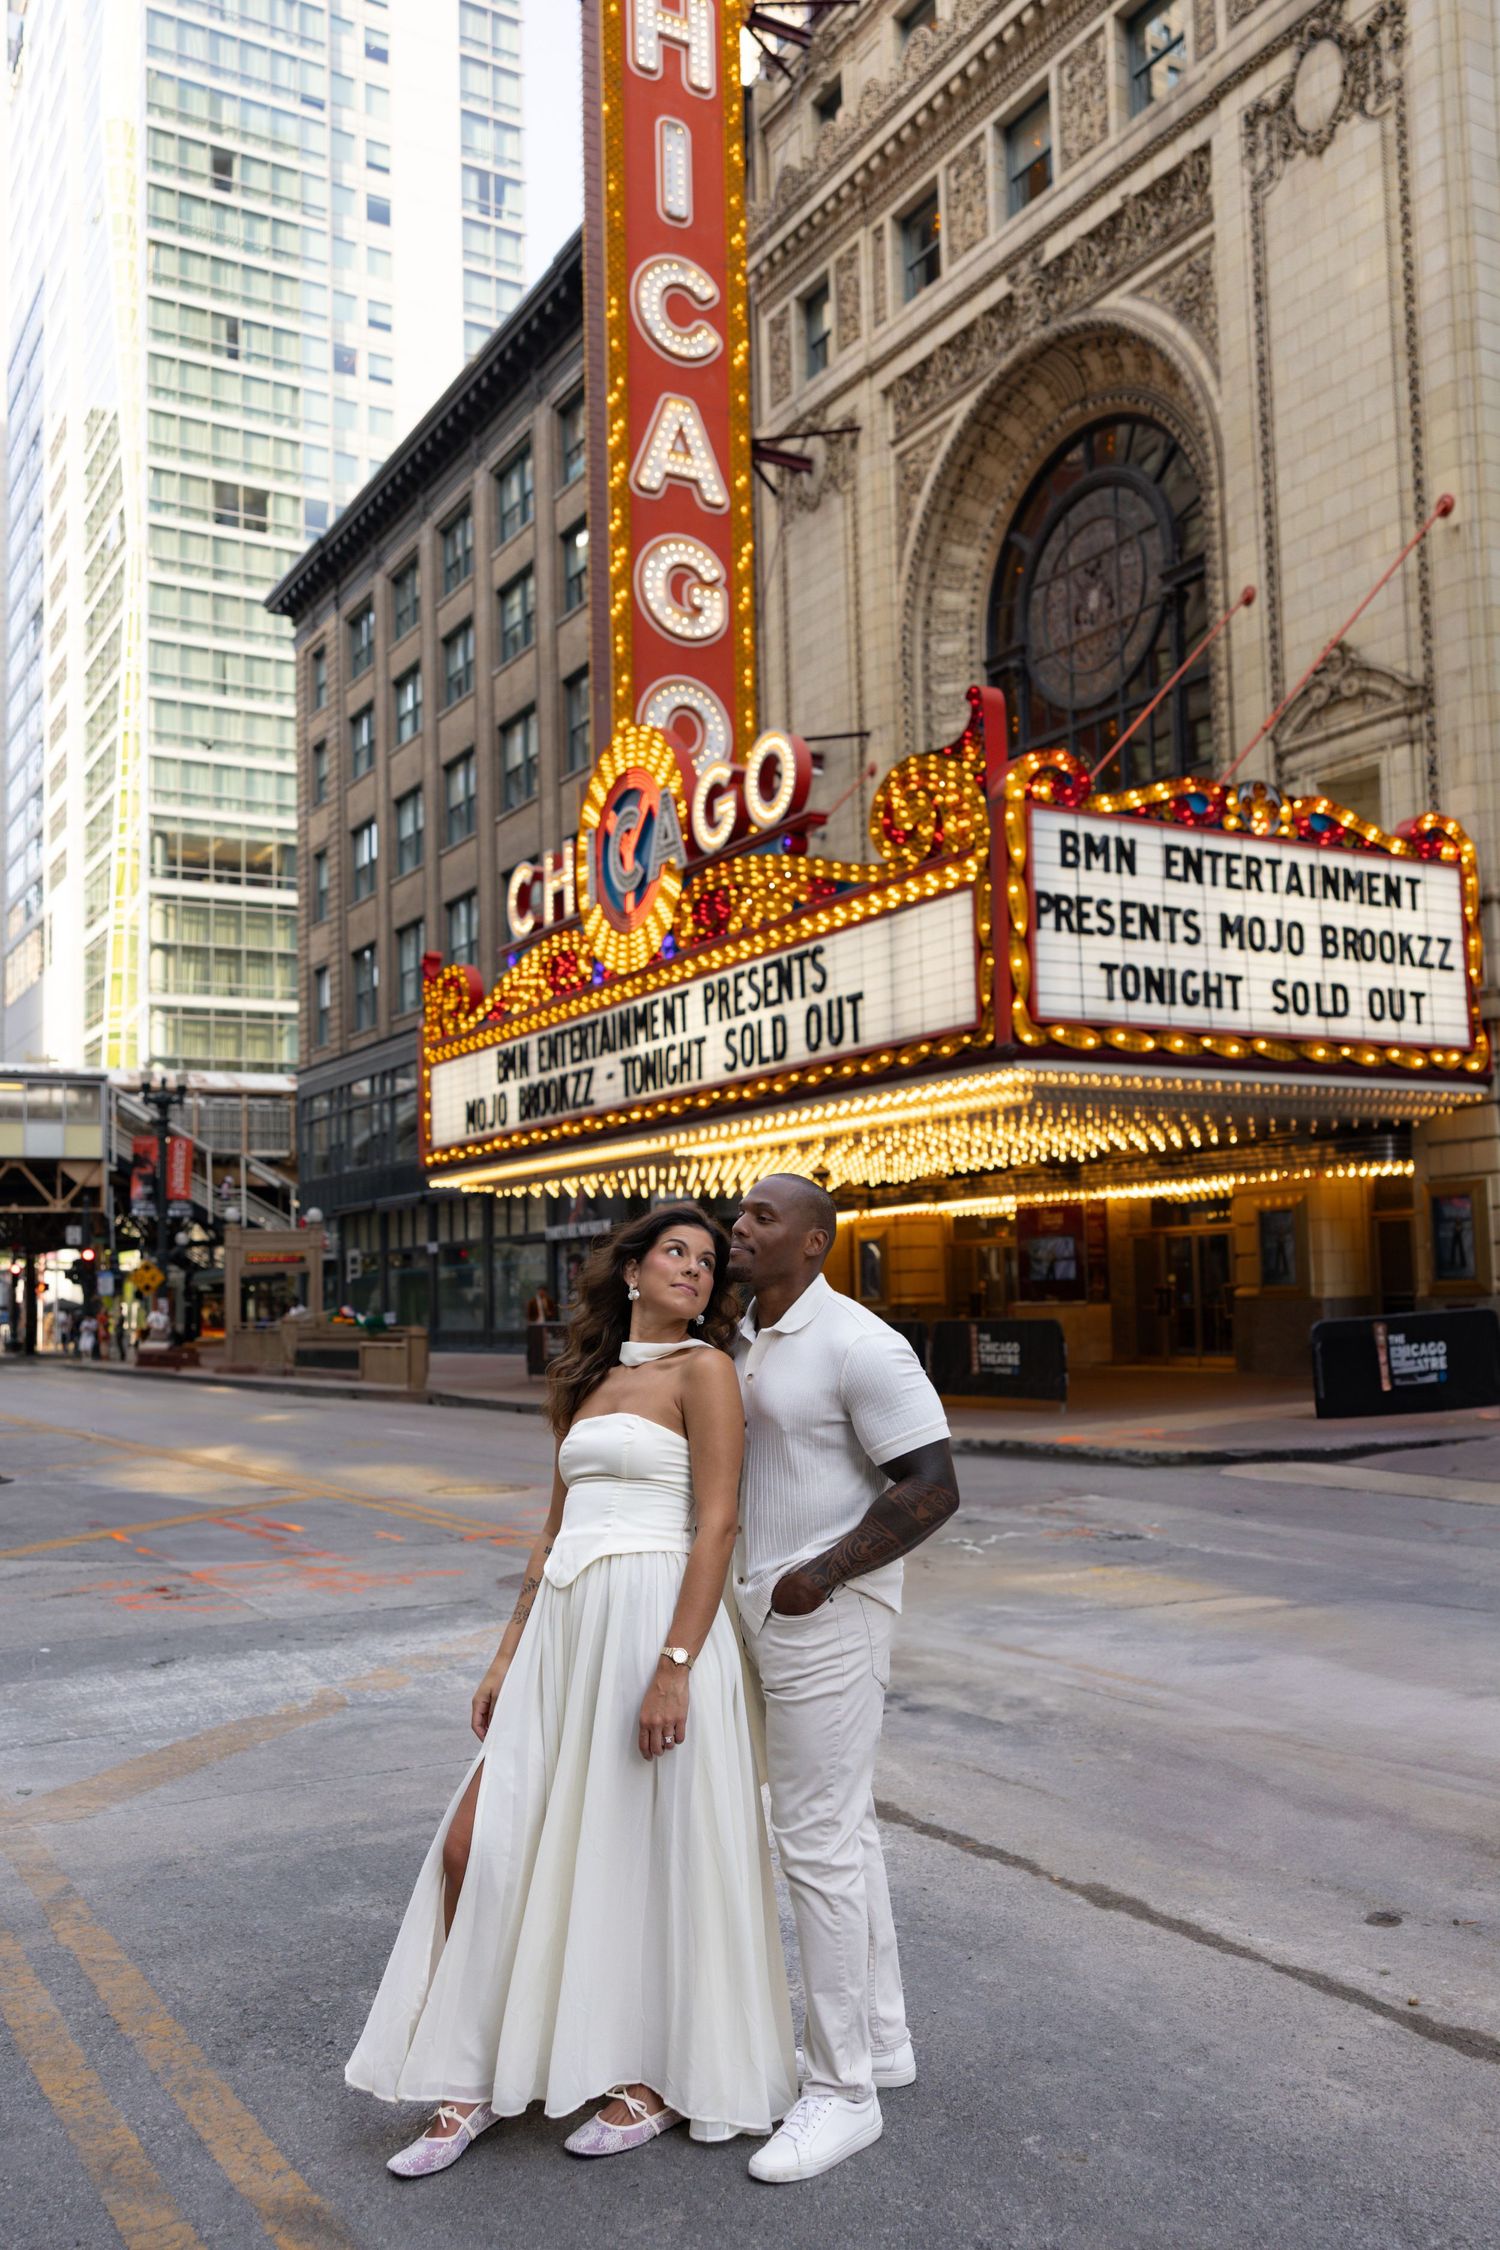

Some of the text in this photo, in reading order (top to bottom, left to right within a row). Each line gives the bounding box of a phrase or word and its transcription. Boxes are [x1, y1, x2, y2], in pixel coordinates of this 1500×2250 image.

[507, 728, 798, 939] CHICAGO
[1059, 828, 1422, 911] BMN ENTERTAINMENT
[1036, 889, 1455, 972] PRESENTS MOJO BROOKZZ
[497, 944, 828, 1084] BMN ENTERTAINMENT PRESENTS
[1100, 962, 1427, 1026] TONIGHT SOLD OUT
[465, 1092, 508, 1135] MOJO
[518, 1066, 595, 1123] BROOKZZ
[620, 1036, 707, 1098] TONIGHT
[723, 1013, 788, 1072] SOLD
[805, 991, 864, 1053] OUT
